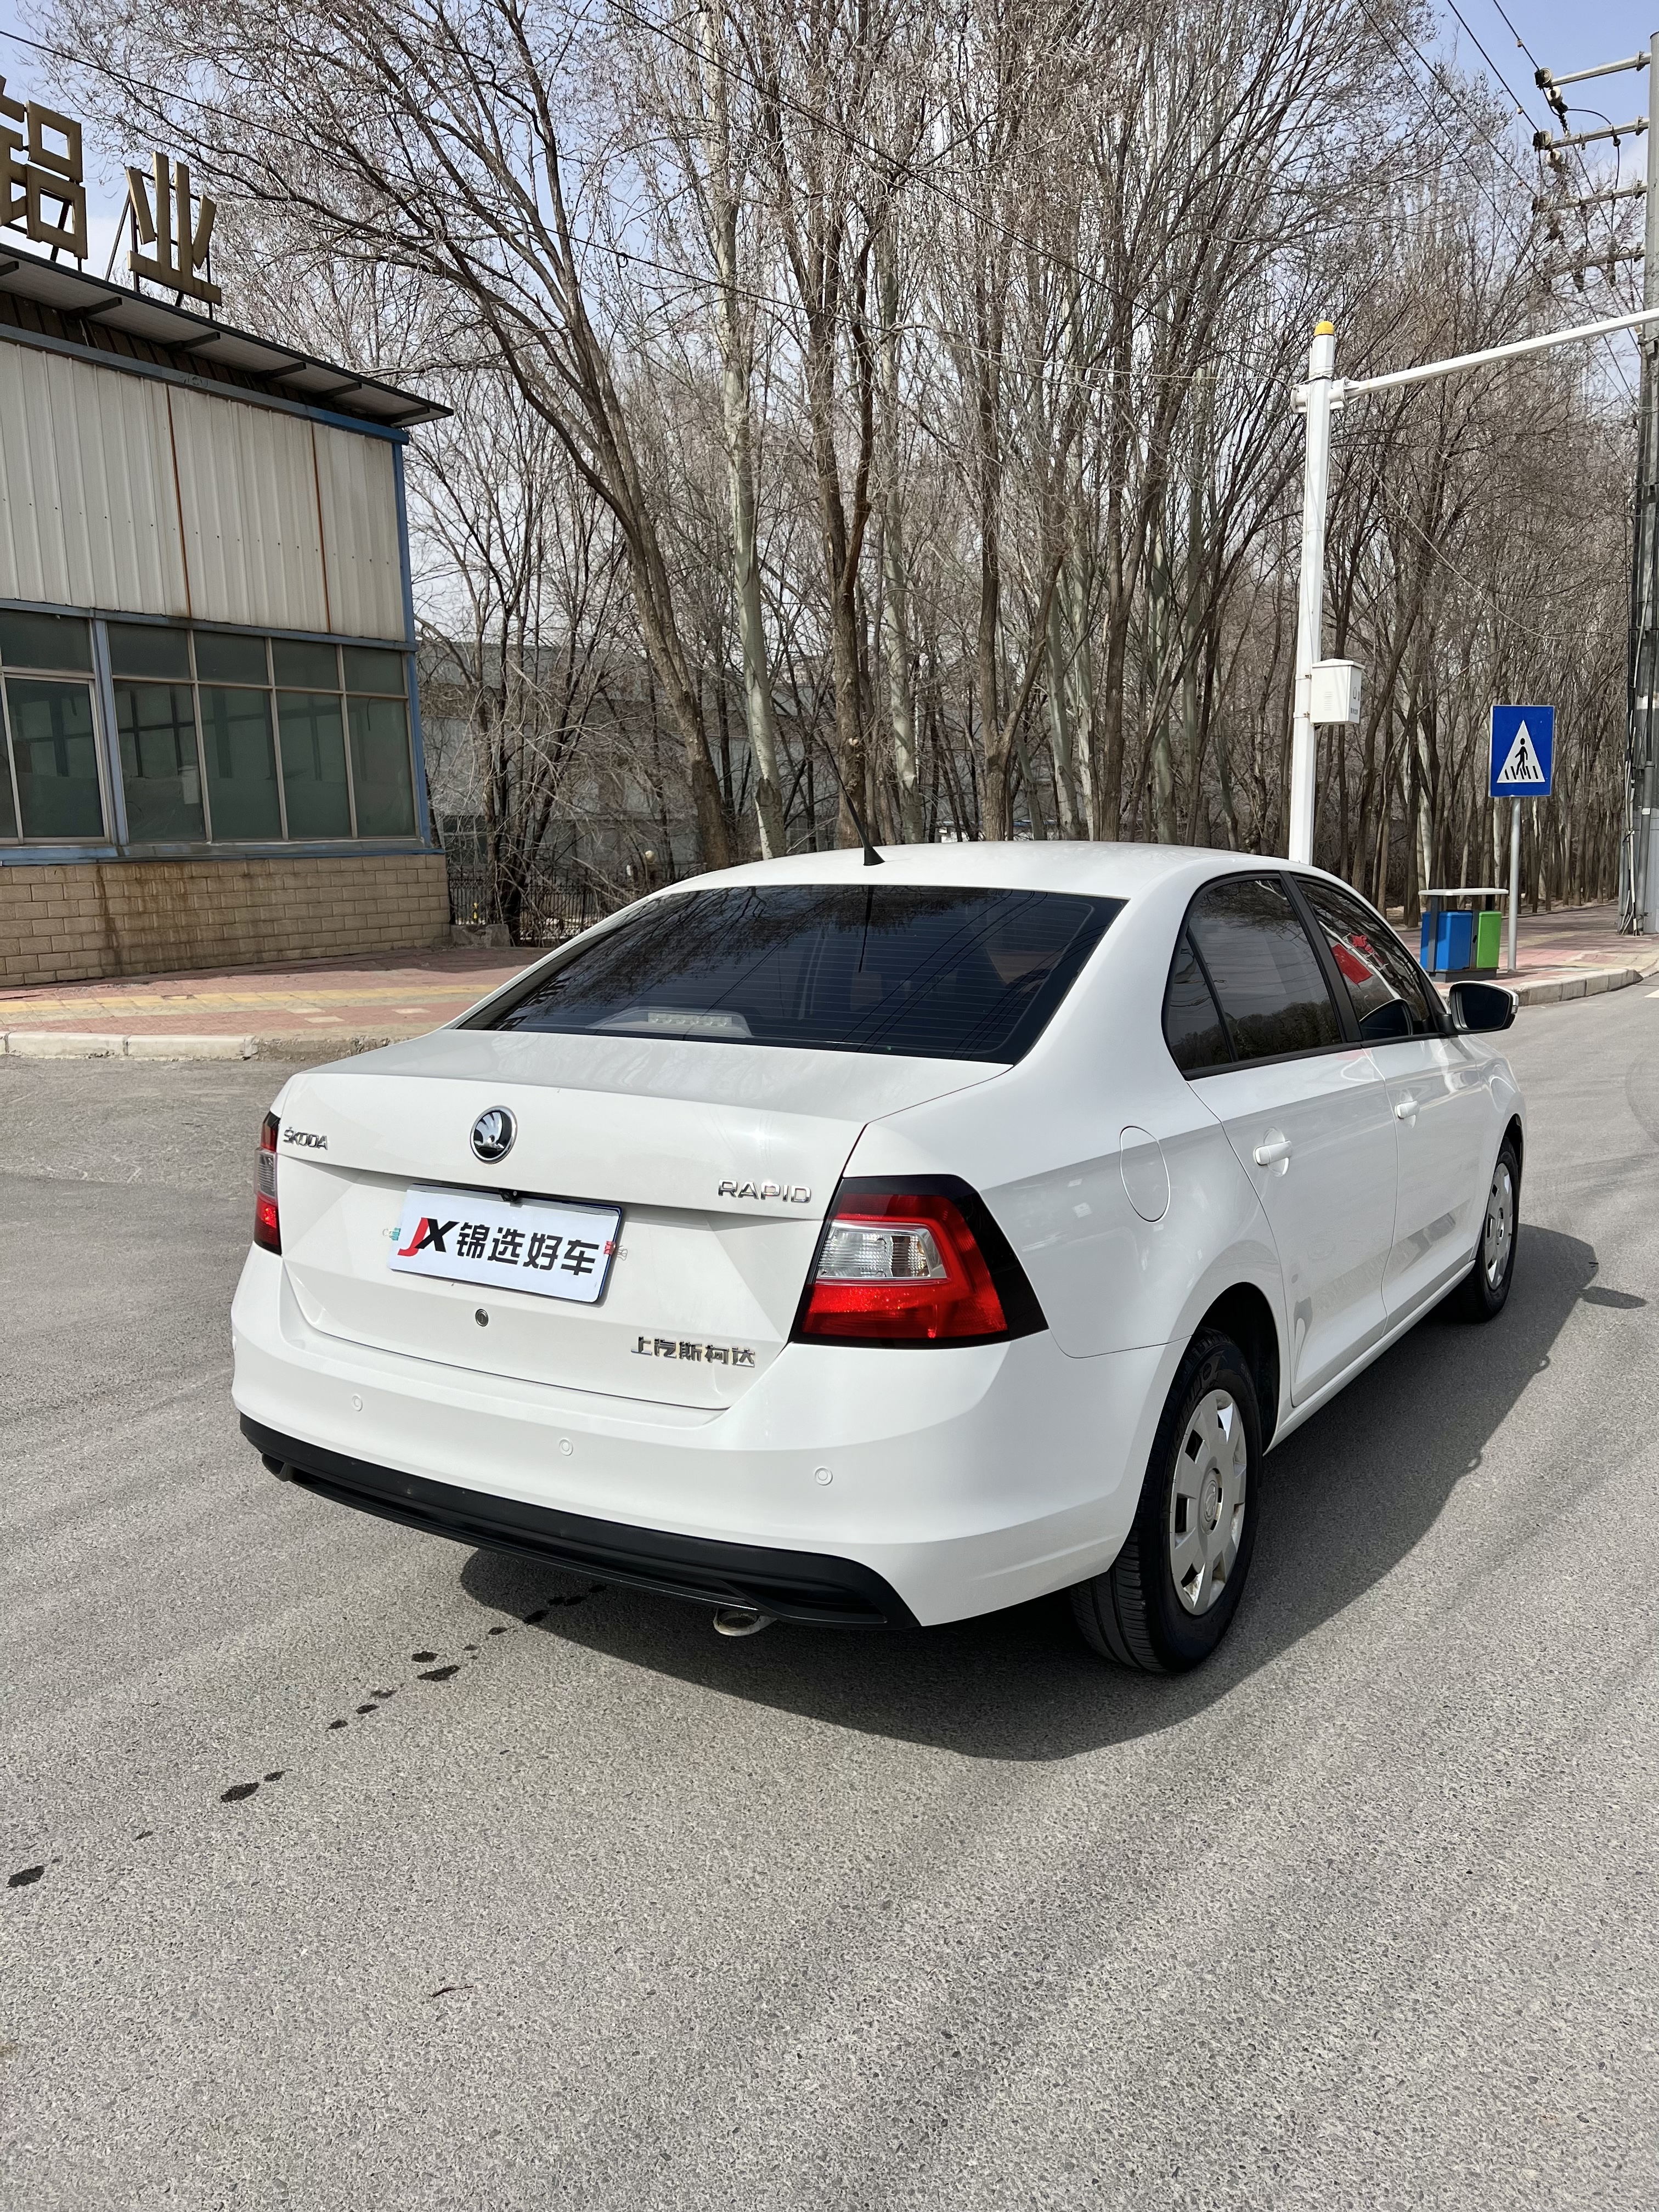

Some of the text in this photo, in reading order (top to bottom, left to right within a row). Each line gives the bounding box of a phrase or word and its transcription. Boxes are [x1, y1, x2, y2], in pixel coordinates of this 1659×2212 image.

[283, 1126, 328, 1150] ŠKODA
[718, 1179, 812, 1203] RAPID
[630, 1335, 755, 1368] 上汽斯柯达
